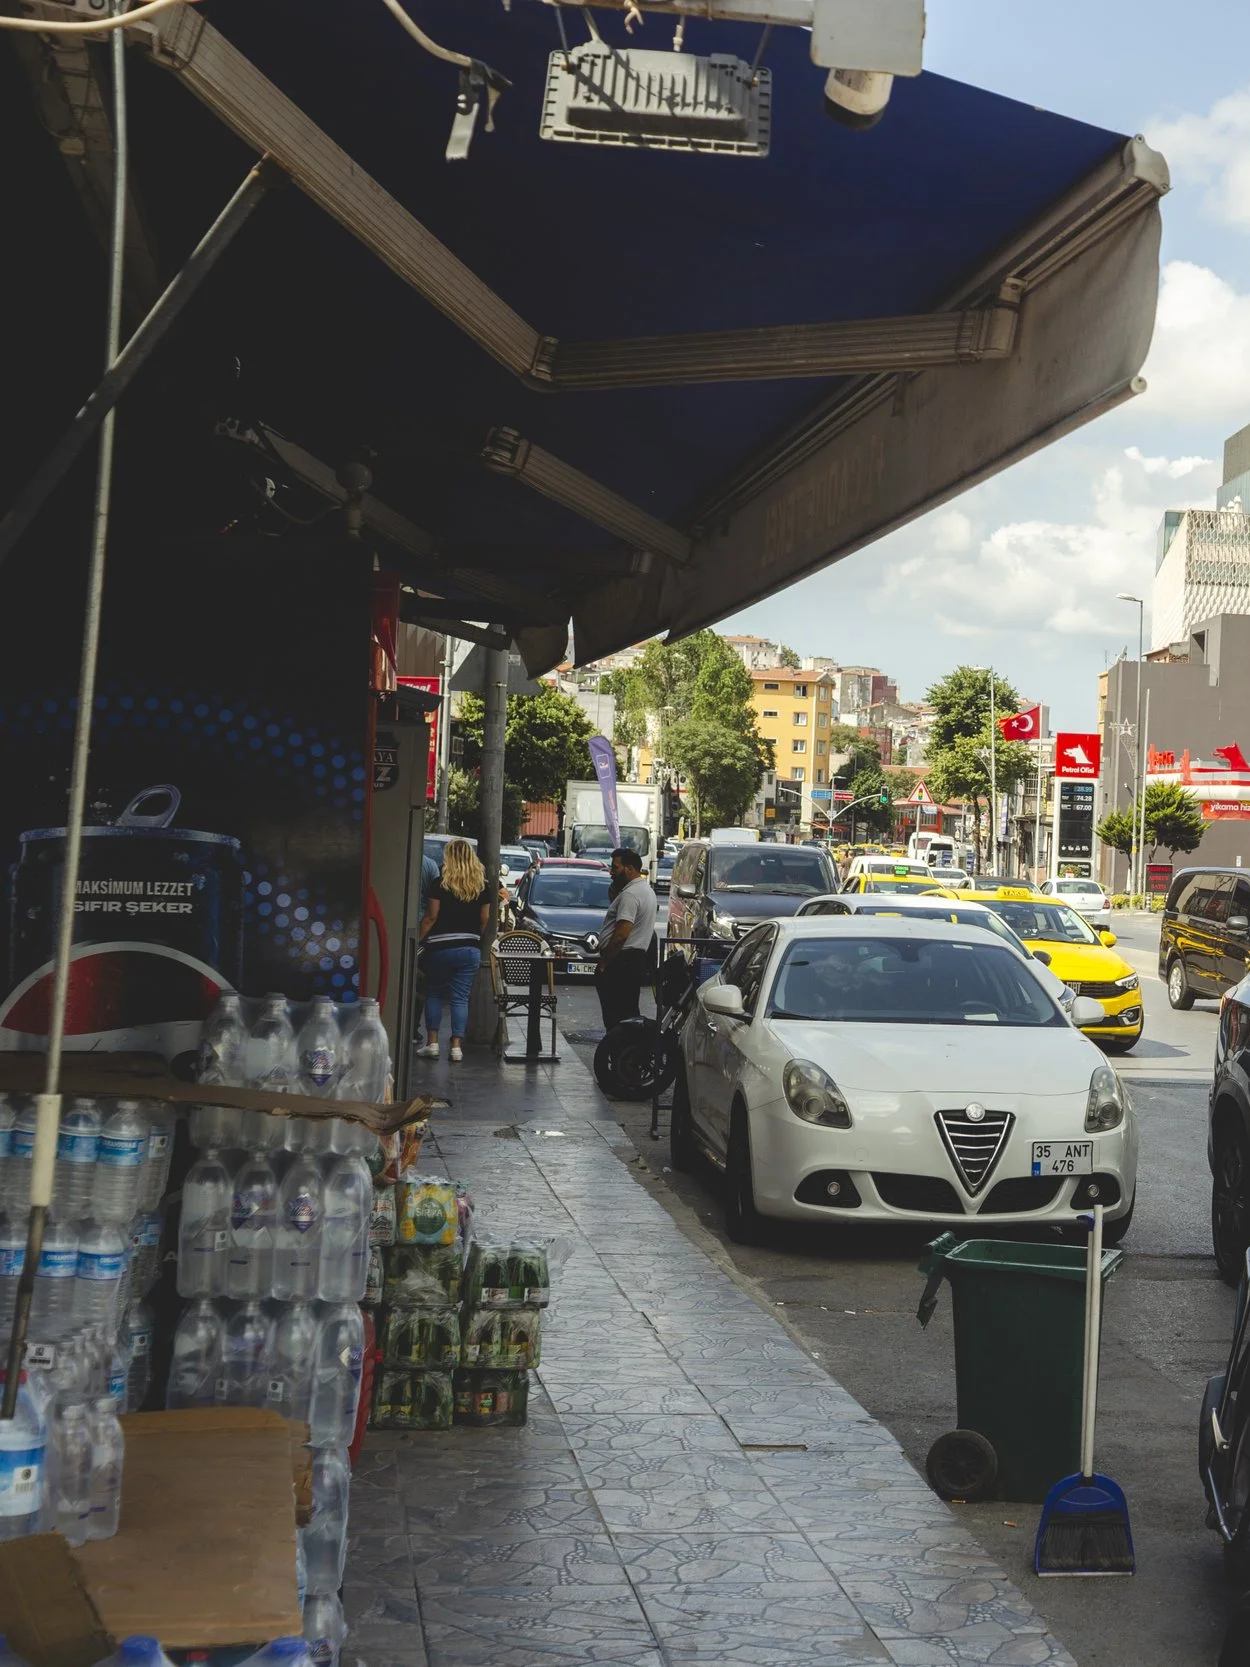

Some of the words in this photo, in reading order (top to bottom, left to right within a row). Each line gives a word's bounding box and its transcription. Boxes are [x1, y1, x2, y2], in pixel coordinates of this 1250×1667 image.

[1061, 766, 1079, 774] Petrol
[1080, 766, 1095, 774] Ofisi
[147, 881, 194, 897] LEZZET
[73, 901, 122, 913] SIFIR
[126, 901, 193, 916] ŞEKER
[1036, 1145, 1051, 1158] 35
[1065, 1144, 1090, 1158] ANT
[1052, 1160, 1074, 1173] 476
